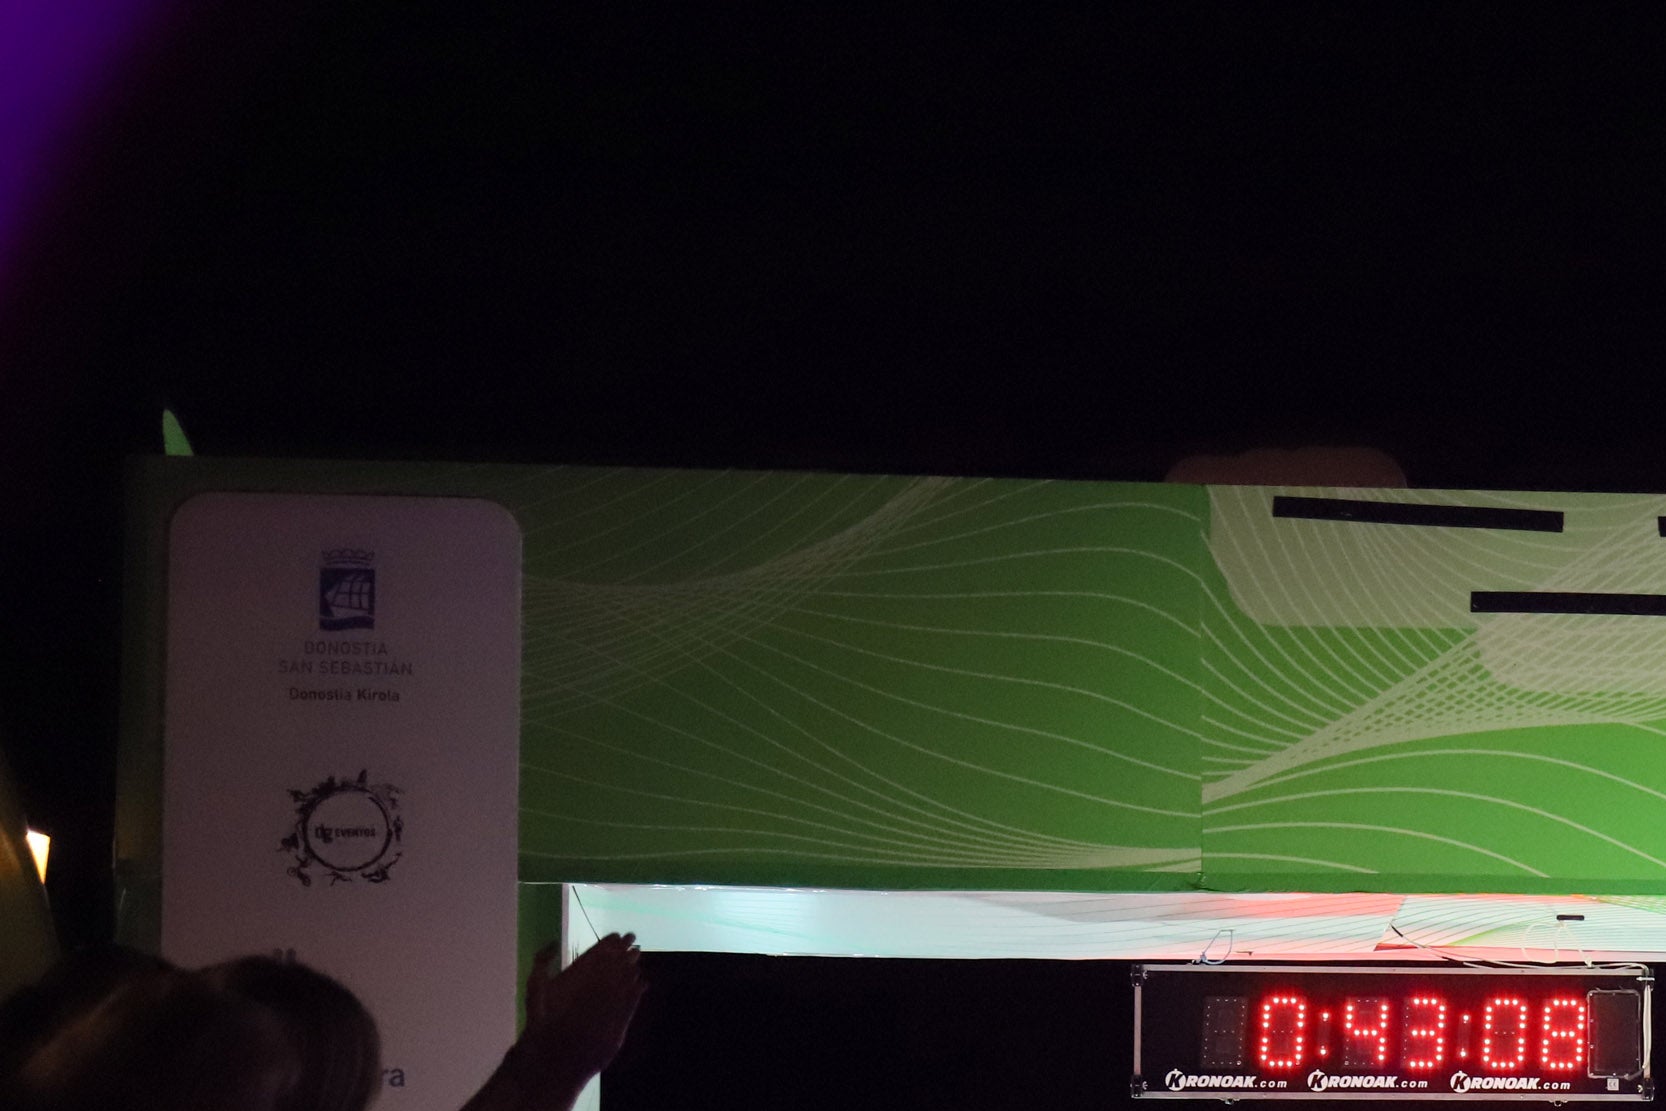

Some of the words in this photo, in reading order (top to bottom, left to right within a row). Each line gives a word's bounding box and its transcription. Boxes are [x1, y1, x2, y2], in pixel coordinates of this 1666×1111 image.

[304, 640, 388, 655] DONOSTIA
[278, 659, 313, 673] SAN
[289, 686, 351, 701] Donostia
[356, 688, 400, 702] Kirola
[1256, 996, 1587, 1070] 0:43:08
